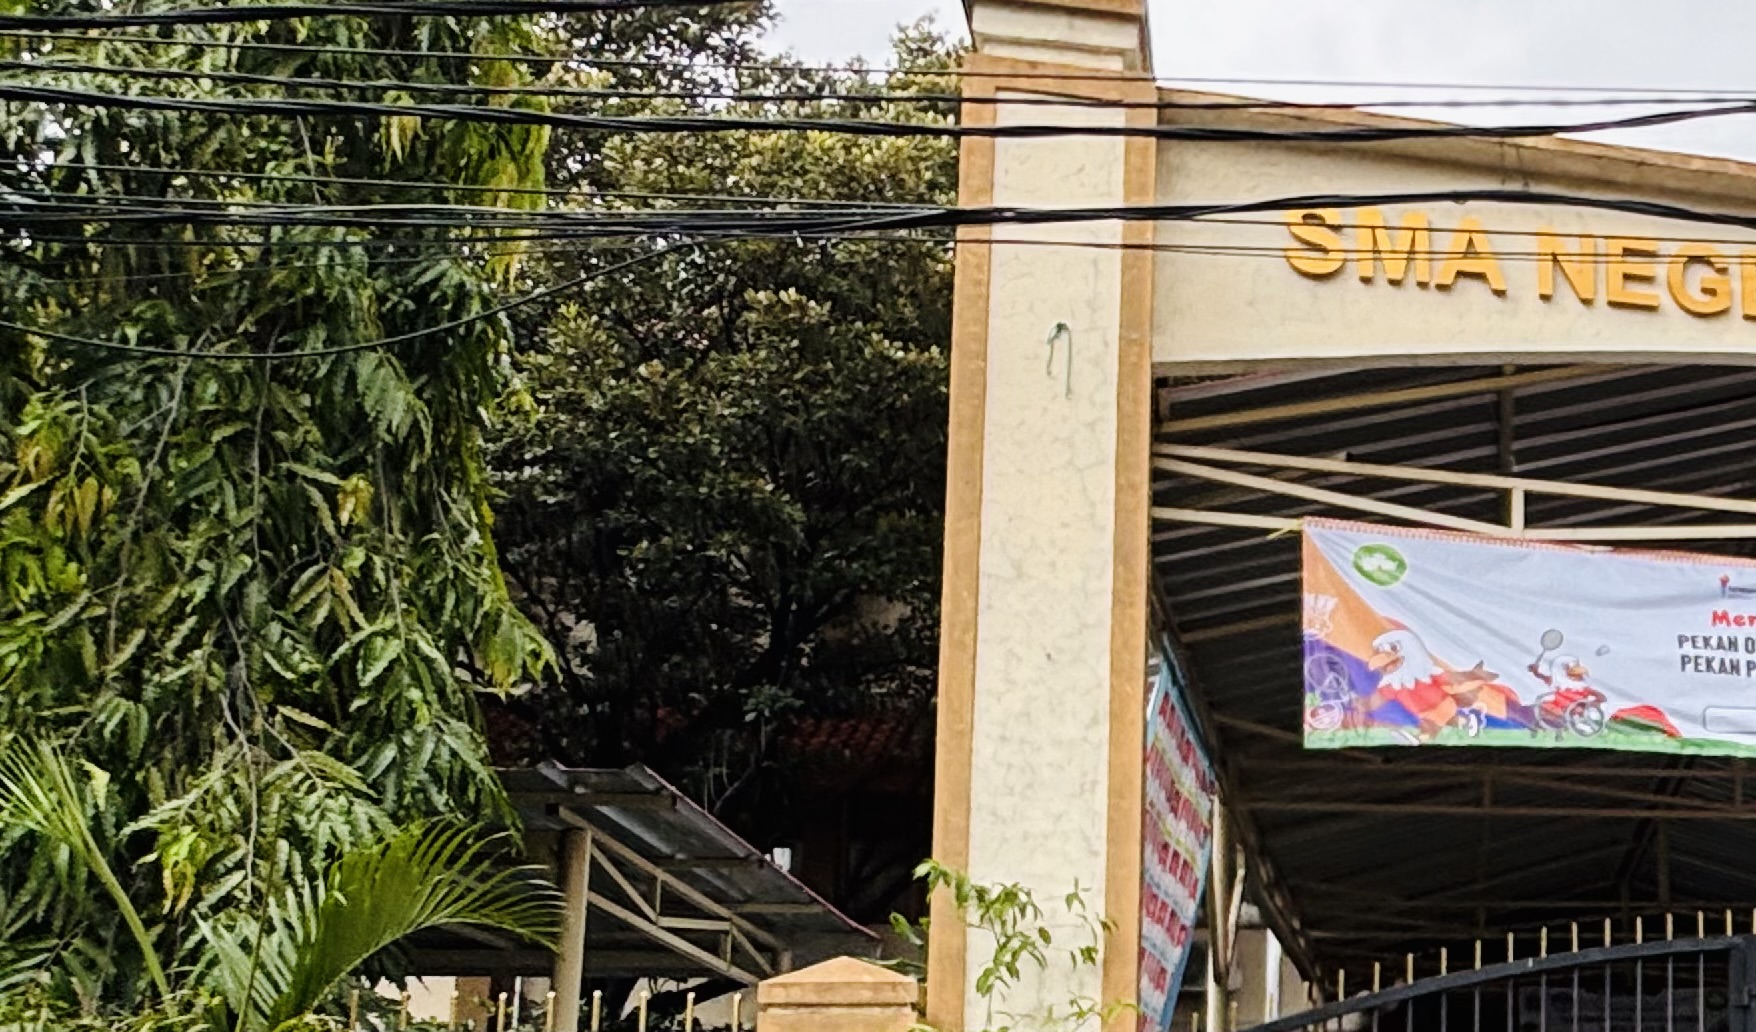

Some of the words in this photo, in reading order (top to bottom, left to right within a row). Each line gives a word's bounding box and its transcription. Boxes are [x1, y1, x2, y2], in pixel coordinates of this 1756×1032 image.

[1282, 207, 1507, 298] SMA
[1677, 633, 1740, 653] PEKAN
[1680, 653, 1742, 677] PEKAN
